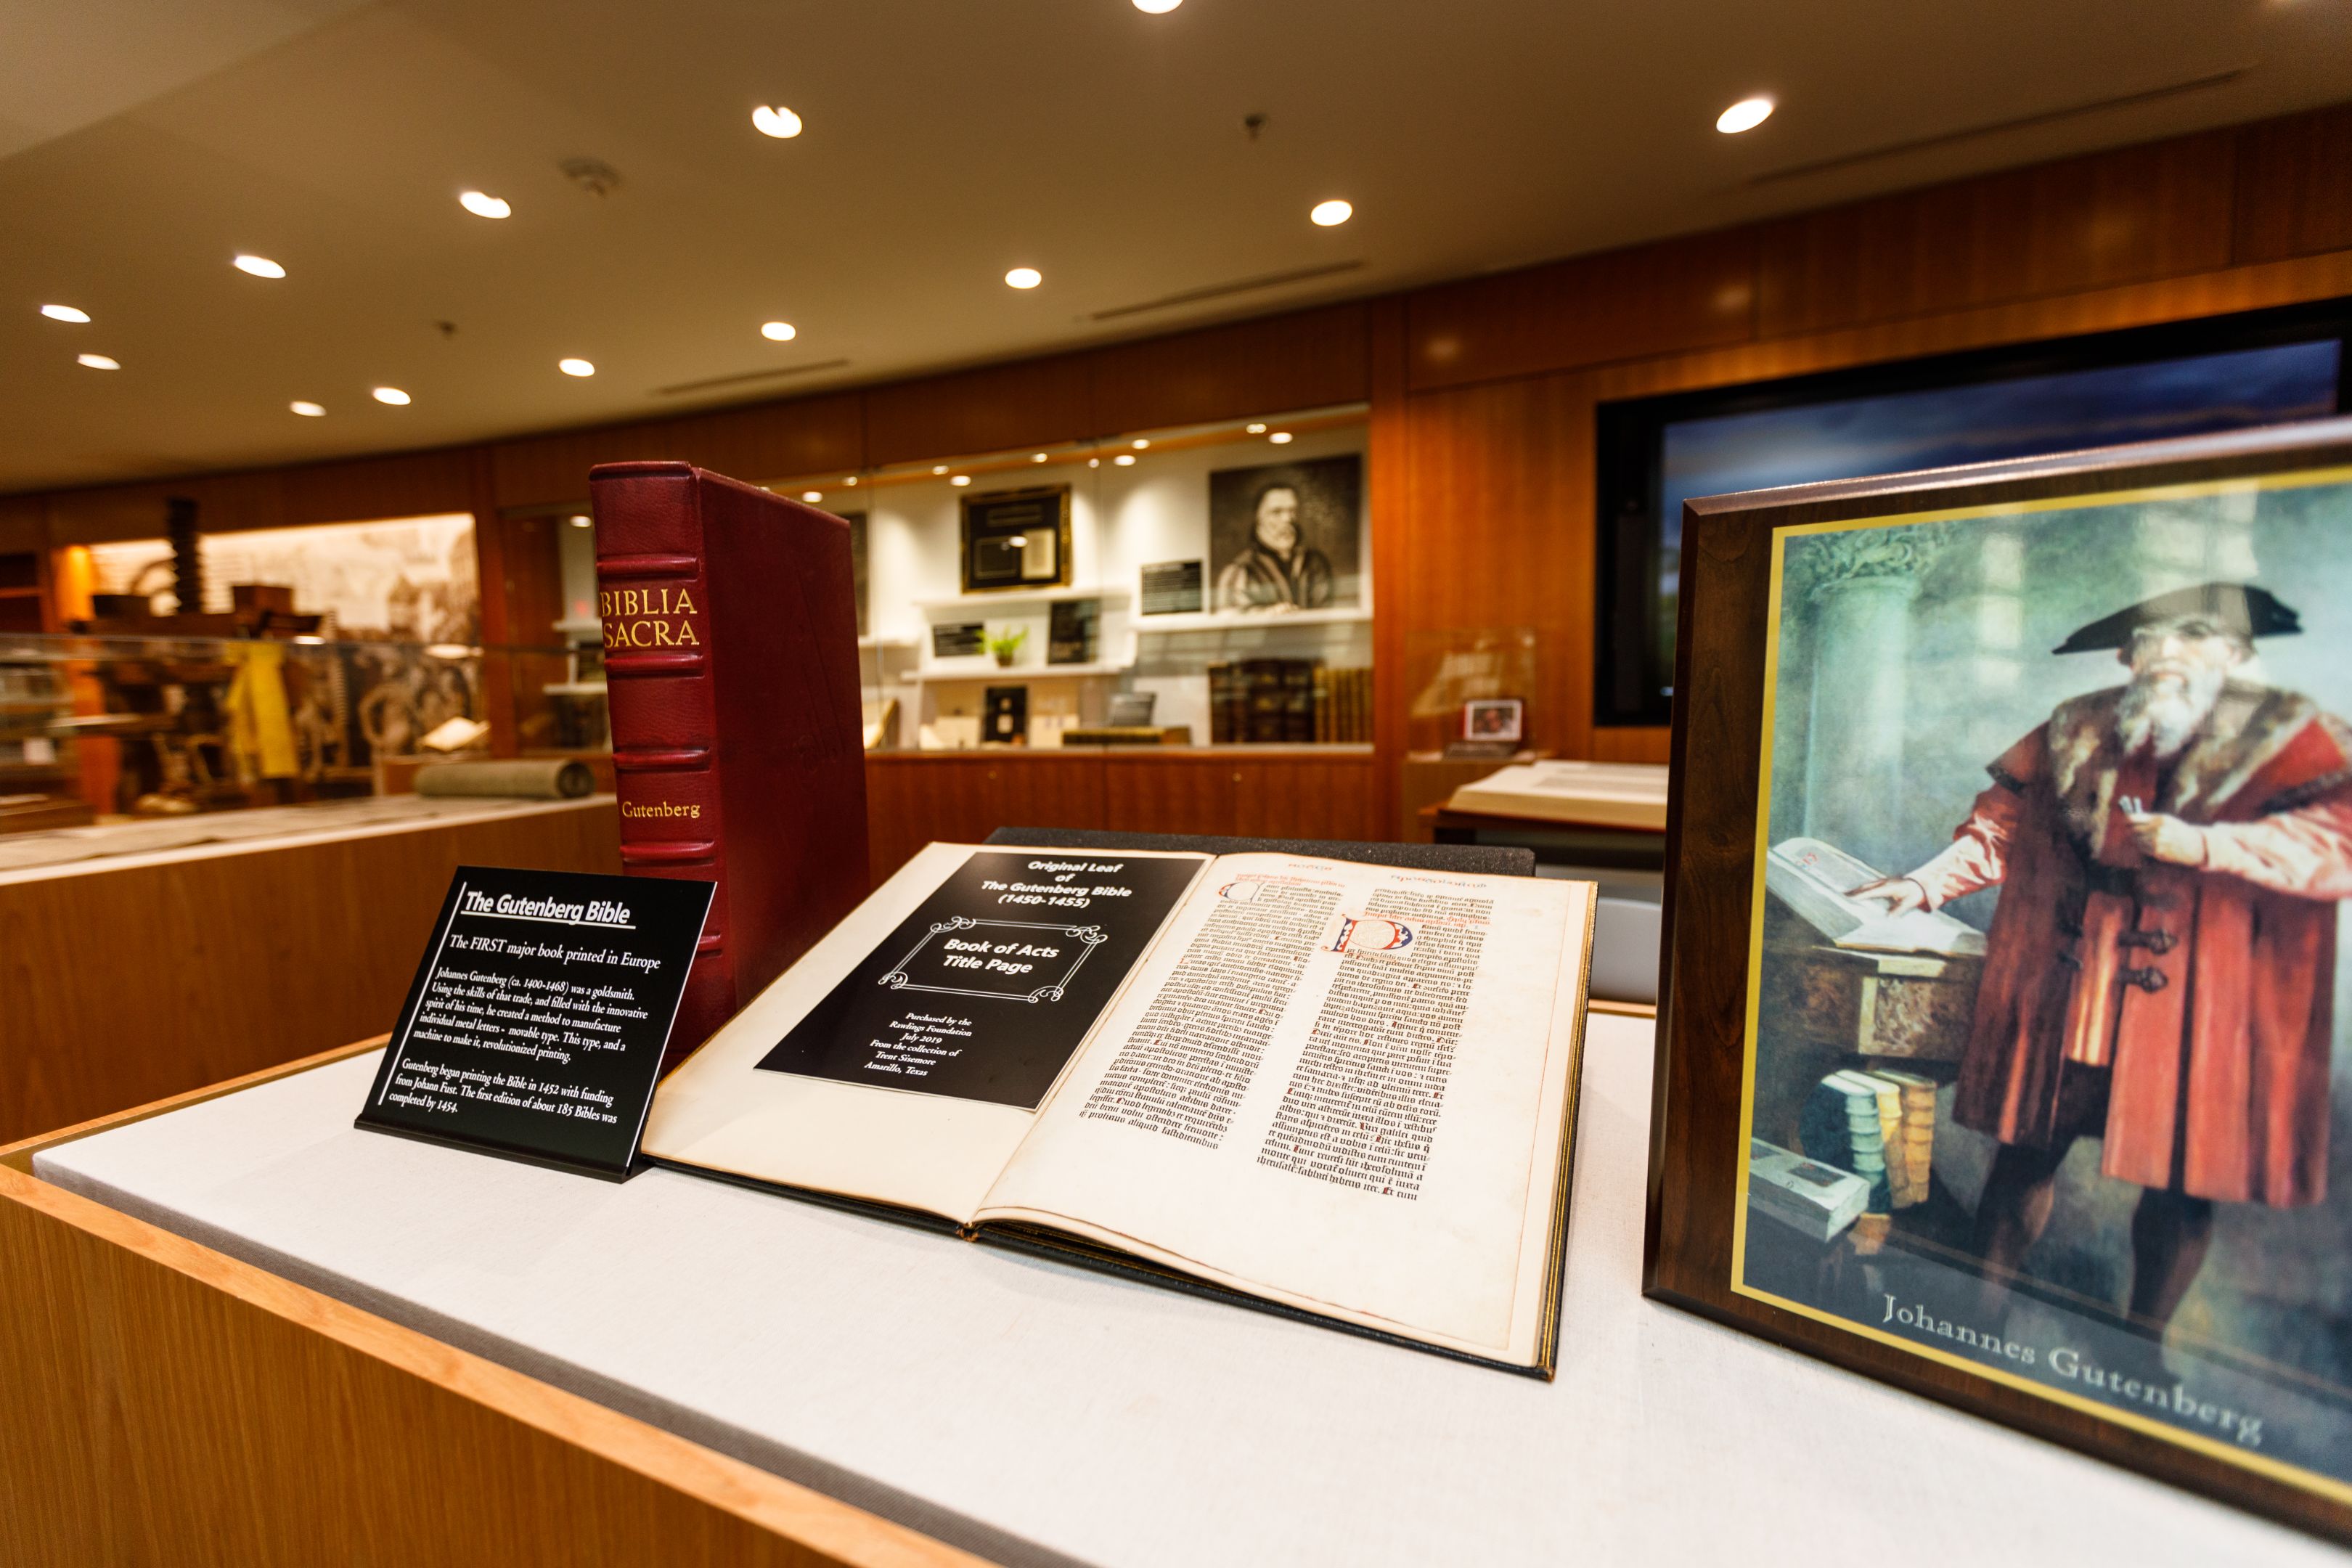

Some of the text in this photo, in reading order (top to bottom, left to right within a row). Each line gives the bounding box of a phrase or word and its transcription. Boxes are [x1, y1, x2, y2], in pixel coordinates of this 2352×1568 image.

[600, 588, 698, 617] BIBLIA
[603, 621, 700, 648] SACRA
[621, 801, 701, 819] Gutenberg
[1027, 860, 1124, 872] Original Leaf
[1054, 873, 1075, 882] of
[981, 880, 1132, 897] The Gutenberg Bible
[465, 891, 630, 925] The Gutenberg Bible
[997, 894, 1090, 908] (1450-1455)
[449, 934, 661, 973] The FIRST major book printed in Europe
[943, 938, 1059, 957] Book of Acts
[943, 955, 1032, 974] Title Page
[435, 966, 467, 980] Johannes
[469, 970, 507, 988] Gutenberg
[507, 975, 520, 989] (ca.
[523, 978, 568, 995] 1400-1468)
[590, 985, 634, 1000] goldsmith.
[431, 981, 648, 1018] Using the skills of that trade, and filled with the innovative
[425, 997, 444, 1011] spirit
[444, 998, 457, 1010] of
[454, 1000, 465, 1011] his
[466, 1002, 484, 1016] time,
[486, 1004, 496, 1016] he
[497, 1008, 525, 1019] created
[530, 1011, 562, 1024] method
[561, 1017, 571, 1026] to
[571, 1018, 621, 1032] manufacture
[905, 1012, 947, 1023] Purchased
[945, 1016, 957, 1025] by
[419, 1010, 456, 1026] individual
[454, 1018, 477, 1029] metal
[475, 1018, 499, 1033] letters
[507, 1026, 539, 1038] movable
[541, 1032, 559, 1045] type.
[563, 1031, 581, 1045] This
[581, 1037, 600, 1051] type,
[603, 1038, 621, 1050] and
[889, 1021, 972, 1036] Rawlings Foundation
[899, 1032, 919, 1042] July
[413, 1028, 443, 1041] machine
[452, 1033, 472, 1045] make
[472, 1035, 481, 1048] it,
[482, 1038, 538, 1055] revolutionized
[535, 1046, 571, 1064] printing.
[870, 1039, 891, 1048] From
[907, 1045, 947, 1055] collection
[875, 1050, 936, 1065] Trent Sisemore
[864, 1061, 928, 1076] Amarillo, Texas
[401, 1058, 614, 1108] Gutenberg began printing the Bible in 1452 with funding
[388, 1092, 457, 1113] completed by 1454.
[394, 1072, 617, 1123] from Johann Fust. The first edition of about 185 Bibles was
[1882, 1294, 2263, 1447] Johannes Gutenberg
